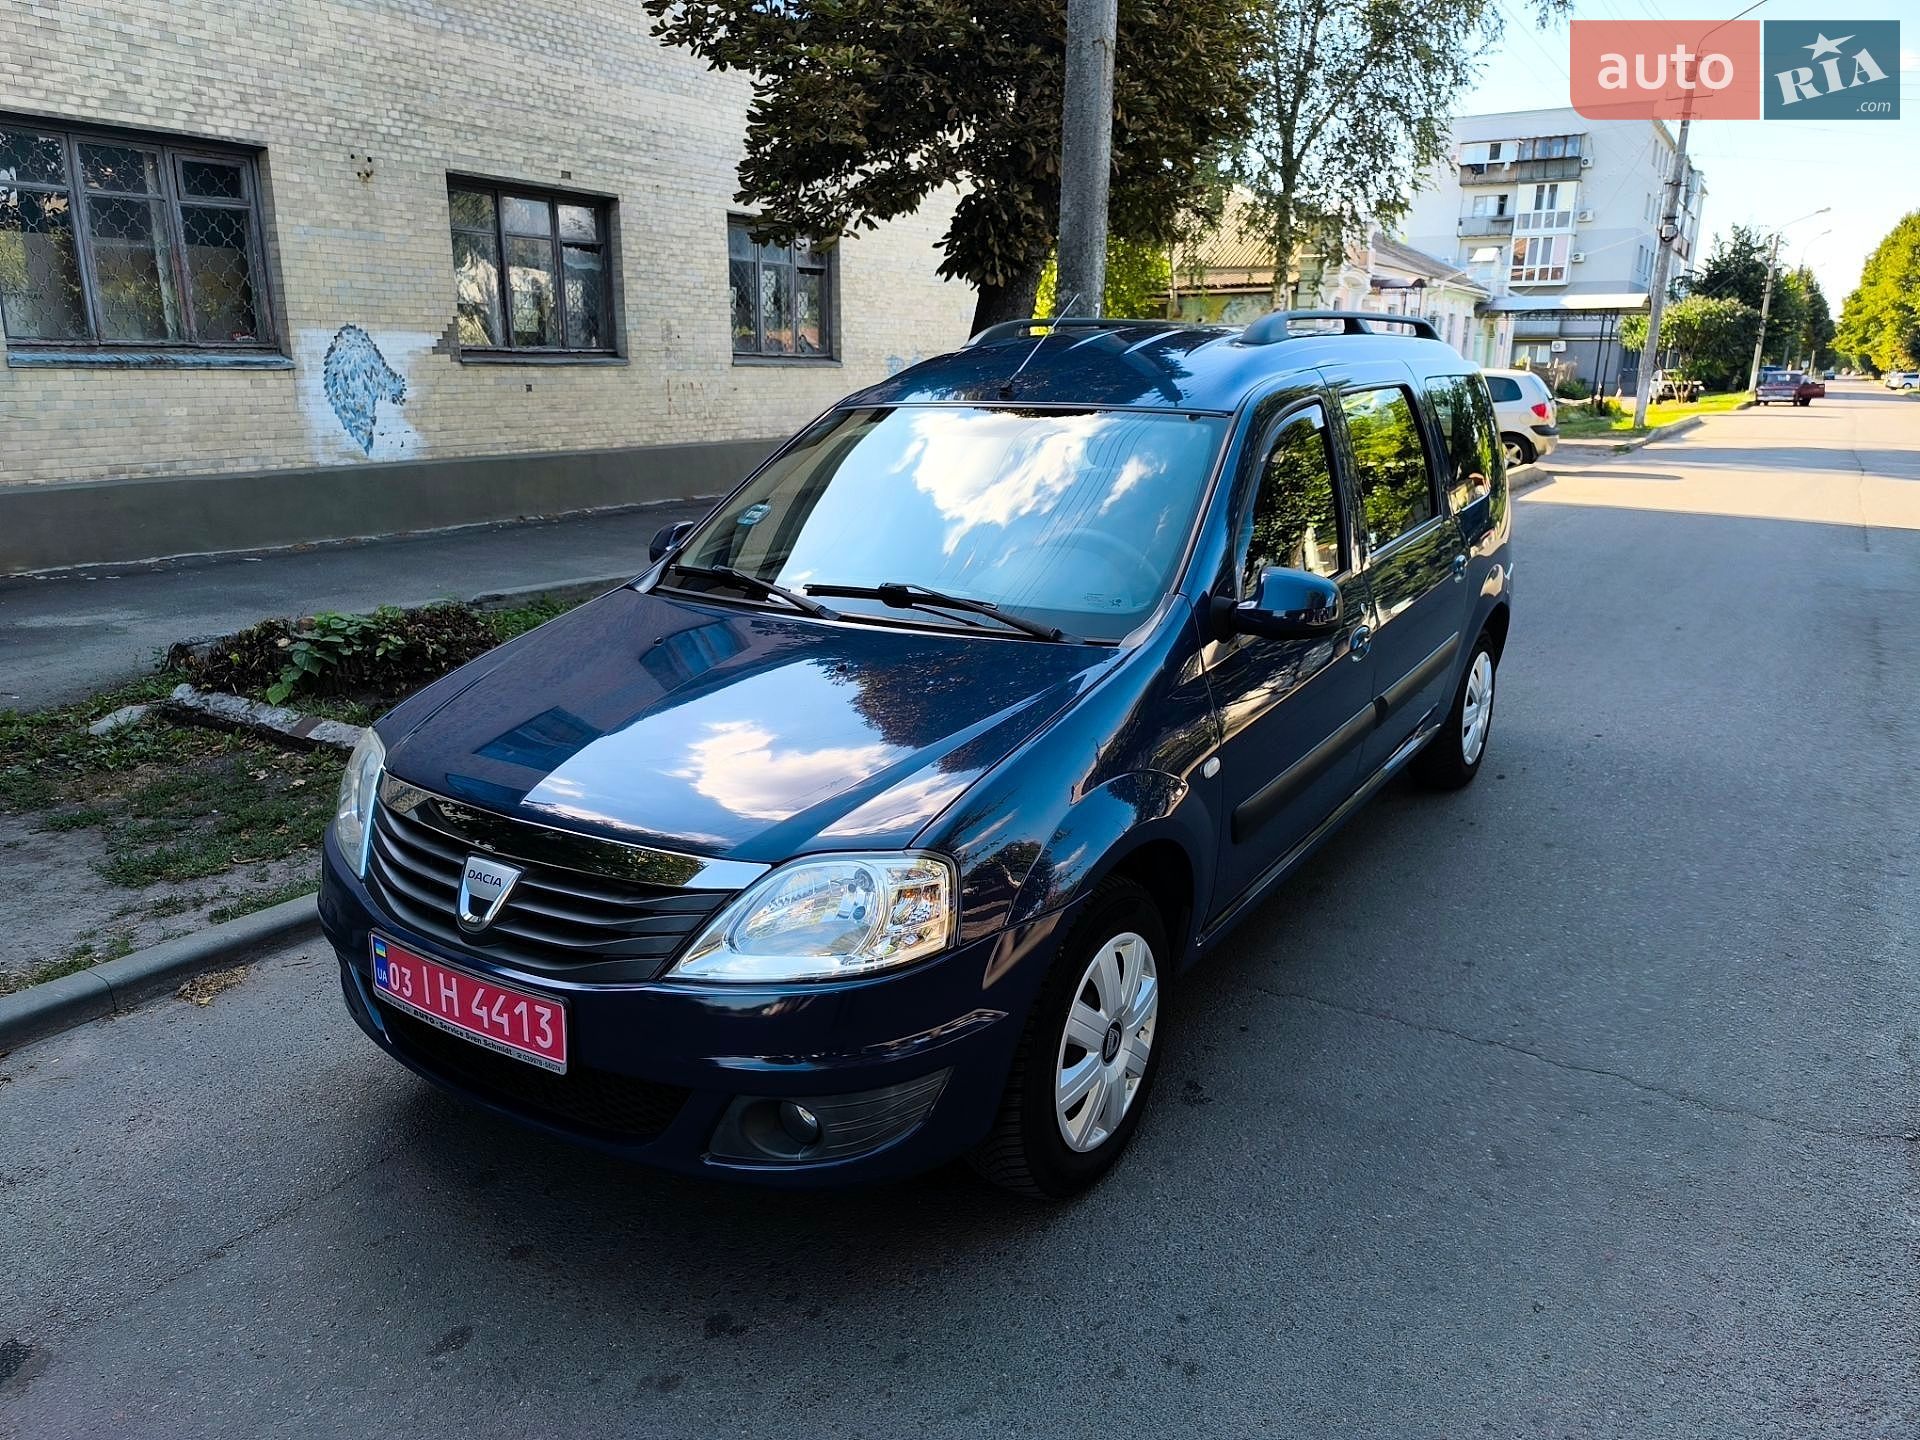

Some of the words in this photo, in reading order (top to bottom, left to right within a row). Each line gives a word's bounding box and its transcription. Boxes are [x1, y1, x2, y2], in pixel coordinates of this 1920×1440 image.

[467, 869, 502, 887] DACIA
[376, 967, 388, 984] UA
[388, 962, 413, 998] 03
[422, 965, 460, 1018] IH
[471, 988, 554, 1049] 4413
[483, 1038, 513, 1056] Schmidt
